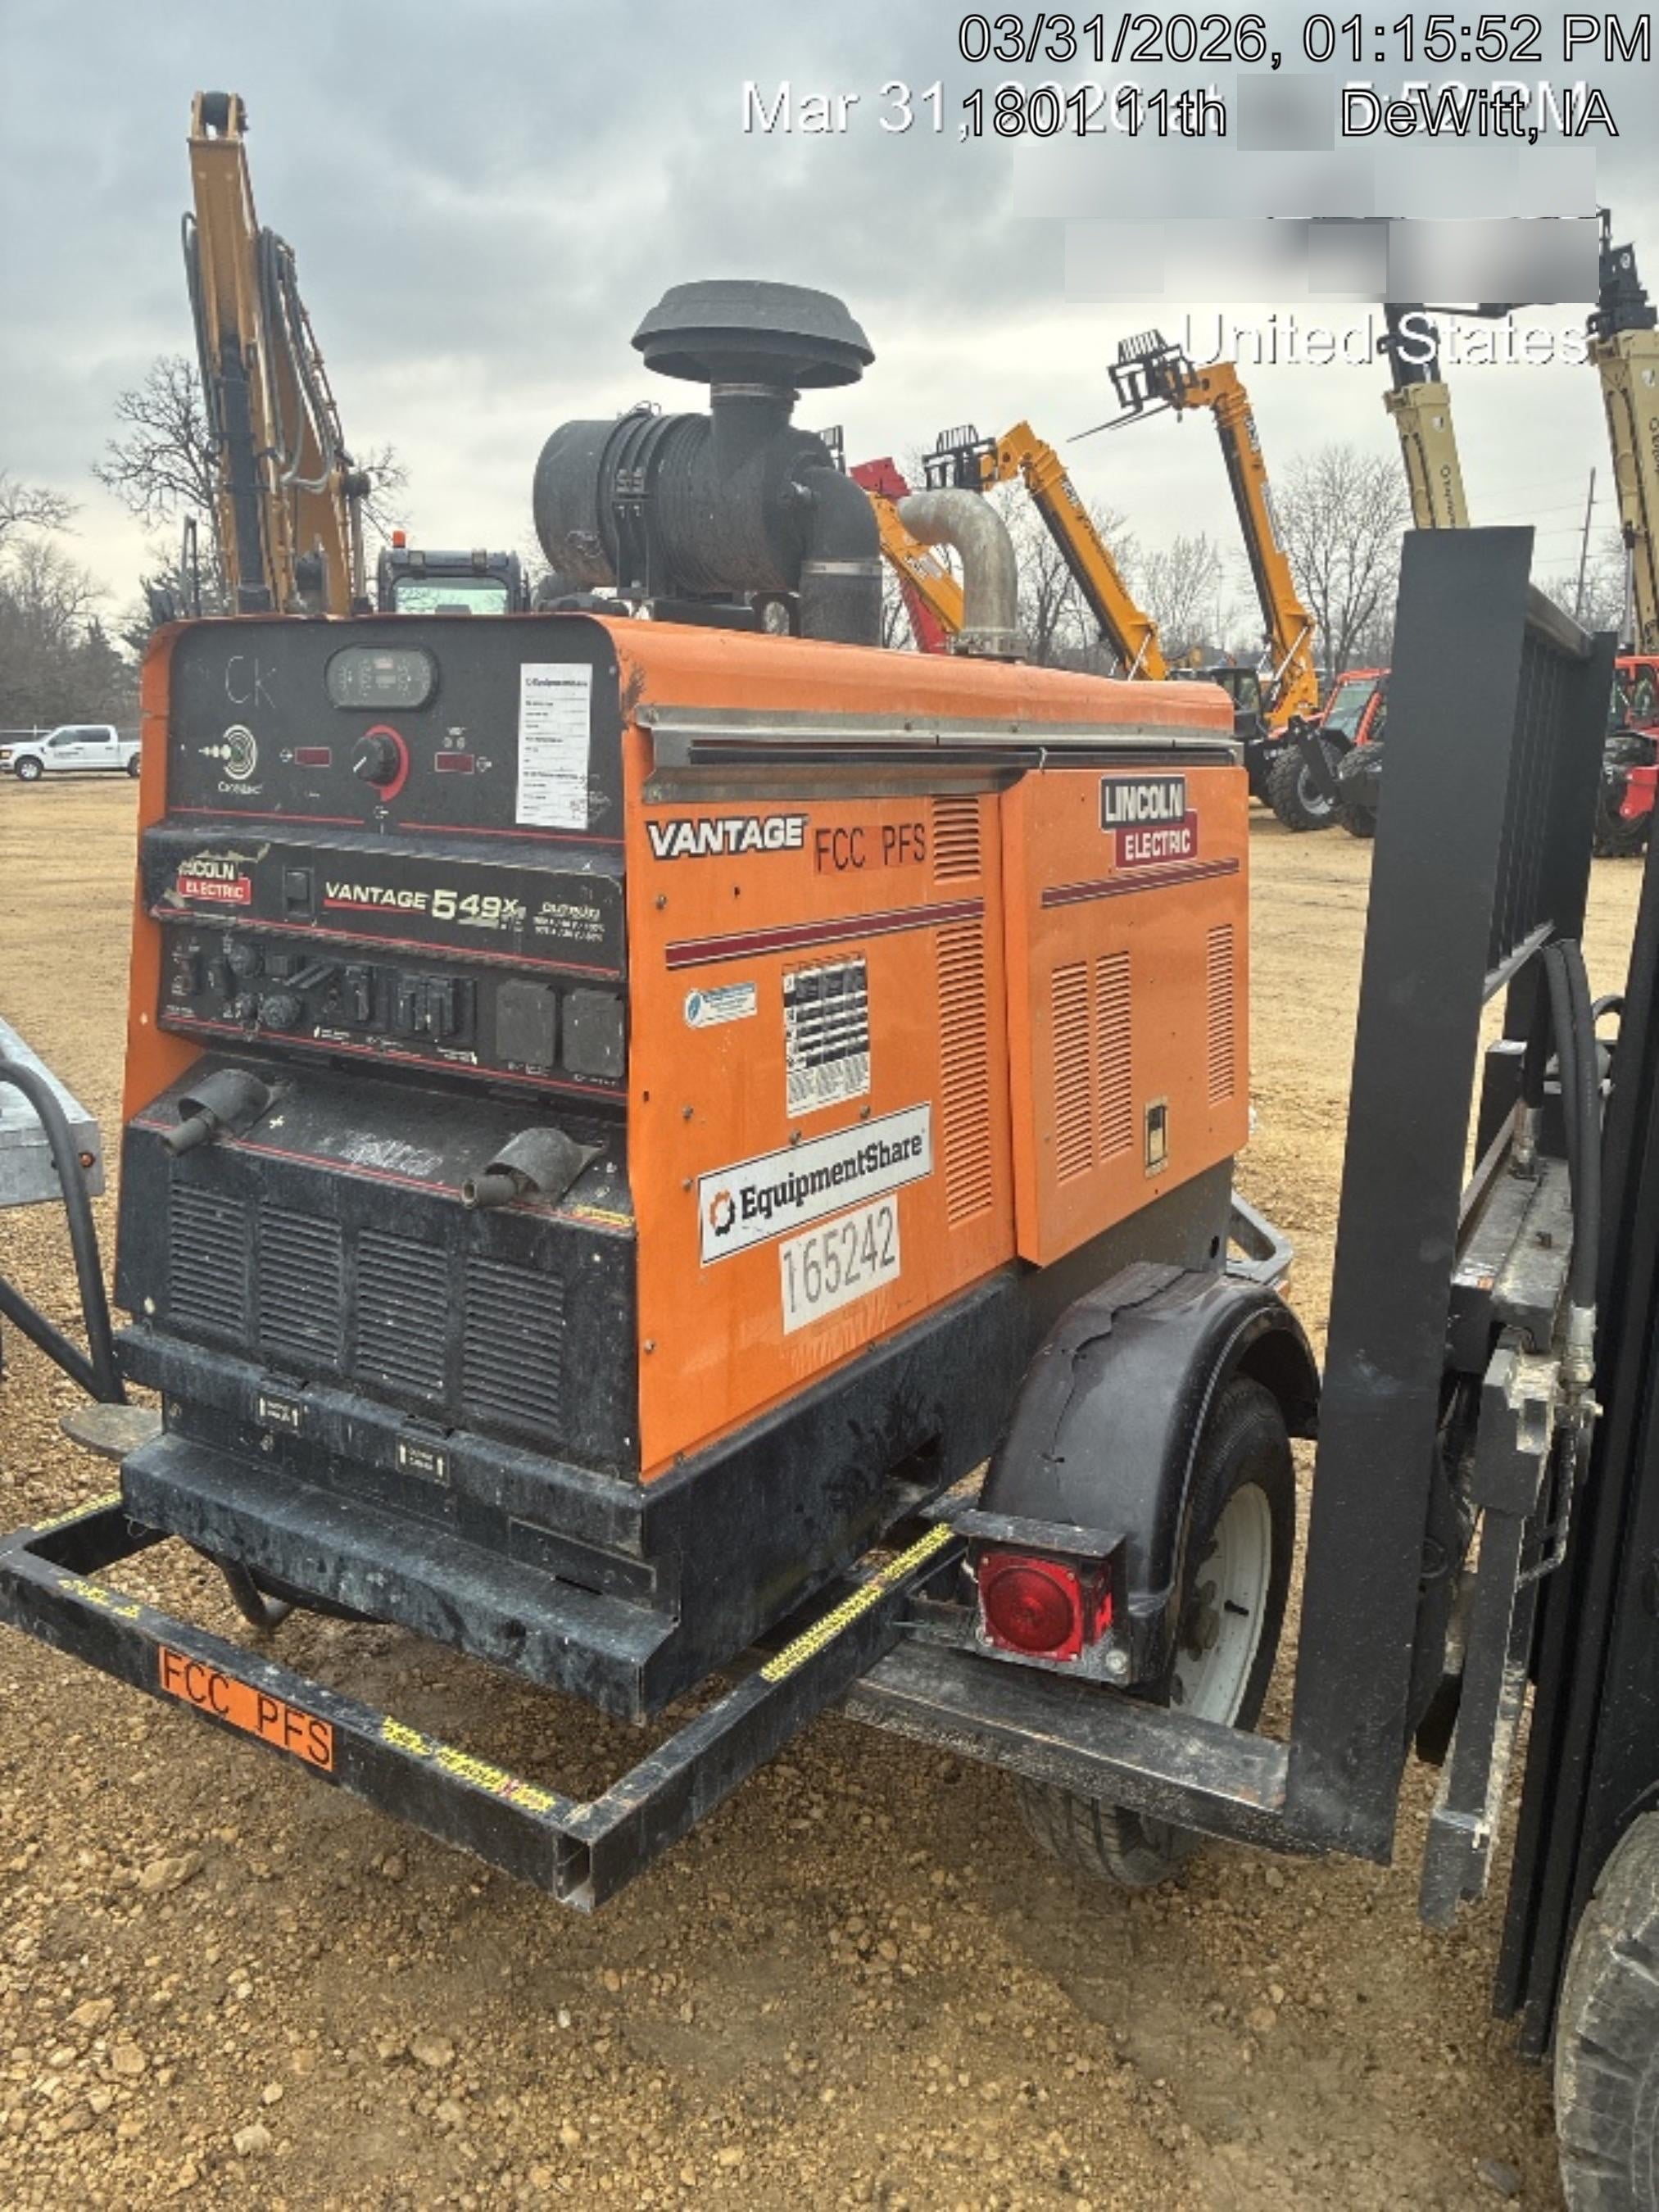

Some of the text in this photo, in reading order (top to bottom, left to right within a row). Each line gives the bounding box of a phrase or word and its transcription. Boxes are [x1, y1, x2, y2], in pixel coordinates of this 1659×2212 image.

[1104, 780, 1185, 823] LINCOLN
[647, 815, 805, 858] VANTAGE
[815, 823, 927, 872] FCC PFS
[1124, 827, 1192, 862] ELECTRIC
[325, 881, 428, 911] VANTAGE
[739, 1134, 923, 1221] EquipmentShare
[782, 1206, 896, 1315] 165242
[164, 1648, 230, 1715] FCC
[256, 1692, 330, 1766] PFS
